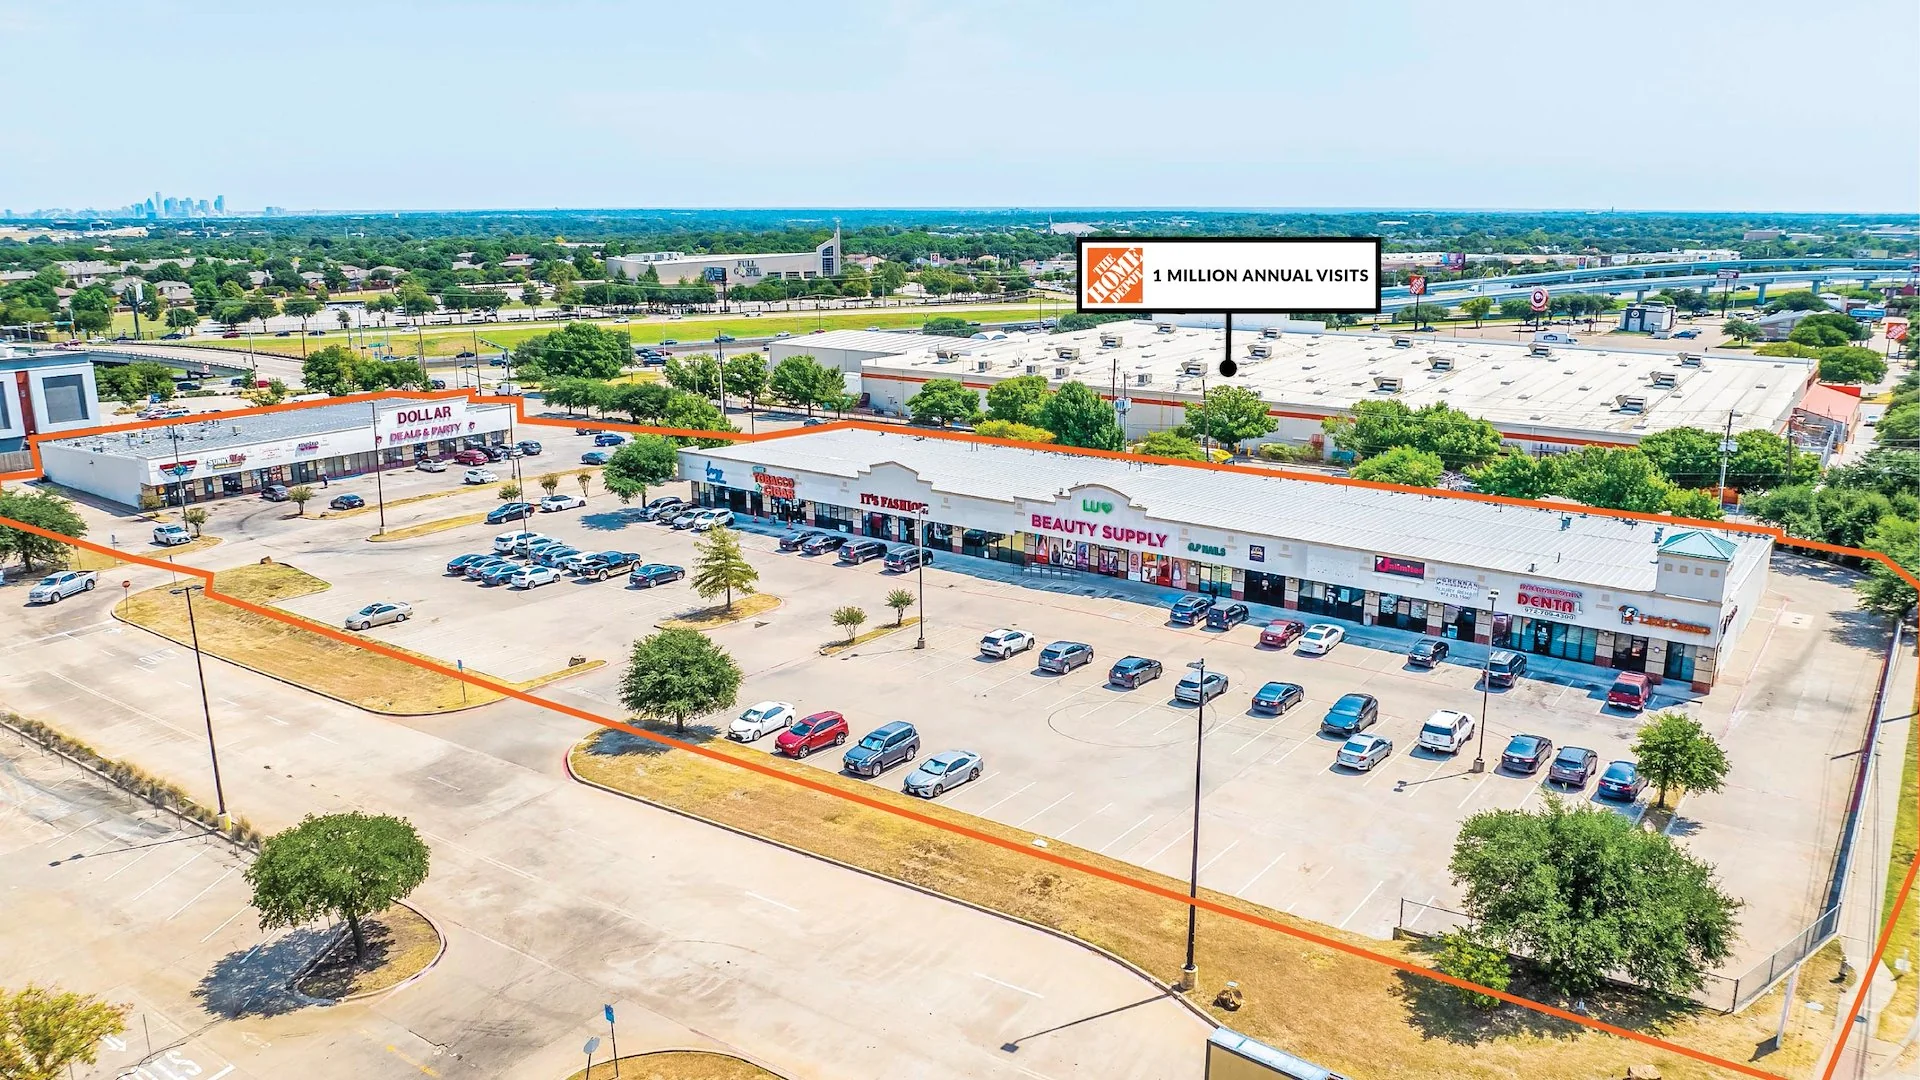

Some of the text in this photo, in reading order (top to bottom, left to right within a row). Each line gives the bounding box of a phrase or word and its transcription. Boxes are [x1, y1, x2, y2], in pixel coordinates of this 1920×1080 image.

[397, 406, 452, 424] DOLLAR
[390, 422, 461, 442] DEALS & PARTY
[752, 472, 795, 488] TOBACCO
[764, 485, 795, 499] CIGAR
[860, 493, 928, 513] IT'S FASHIO
[1032, 514, 1168, 548] BEAUTY SUPPLY
[1202, 545, 1226, 556] NAILS
[1517, 592, 1583, 614] DENTAL
